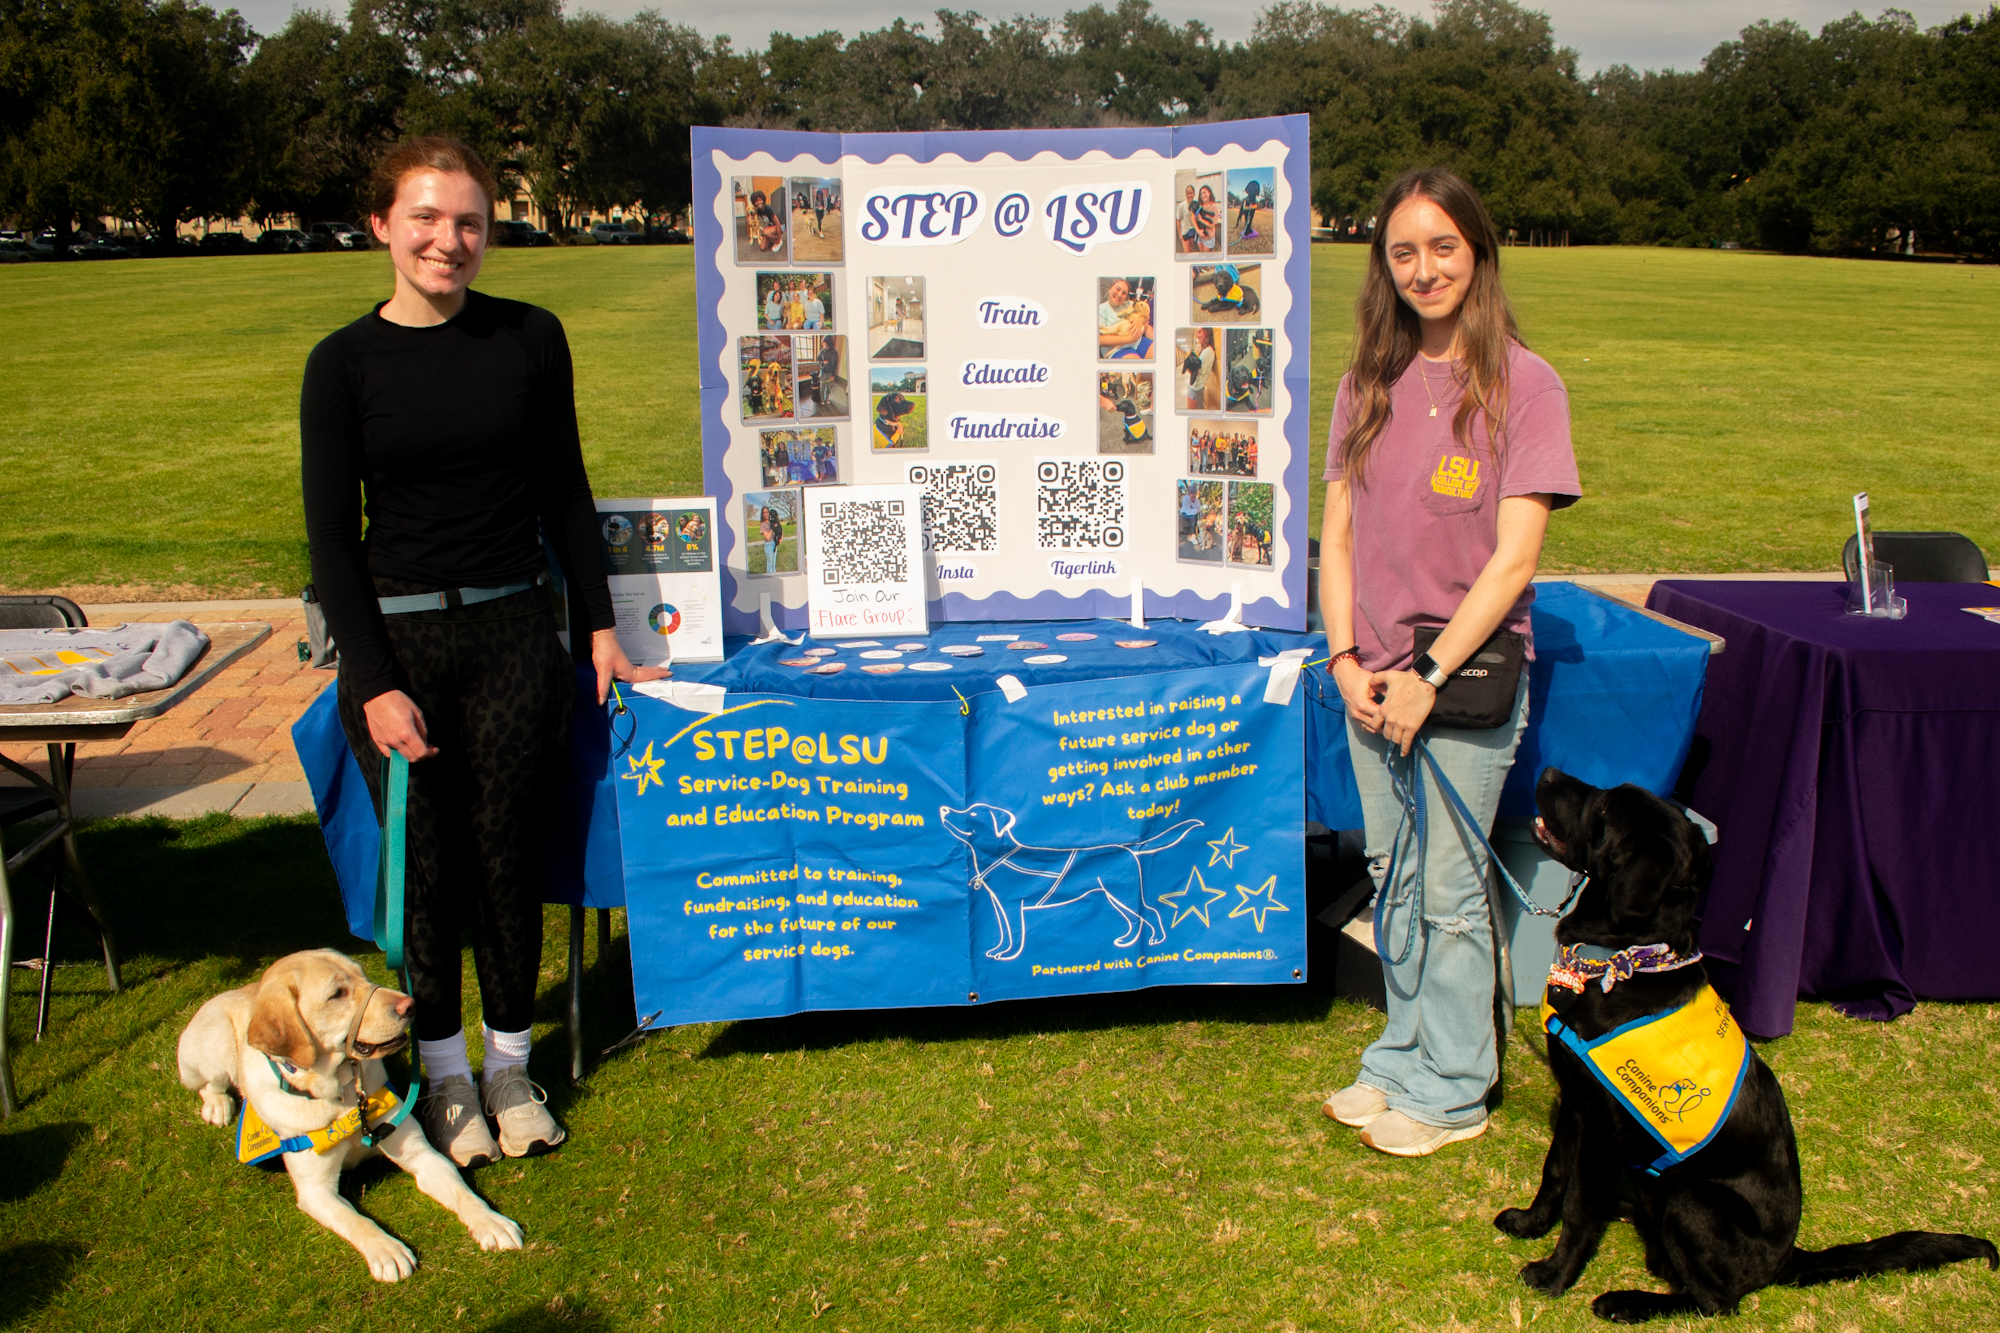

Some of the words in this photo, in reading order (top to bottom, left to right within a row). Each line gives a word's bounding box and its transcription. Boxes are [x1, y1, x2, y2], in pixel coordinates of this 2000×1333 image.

[862, 190, 978, 241] STEP
[994, 193, 1030, 237] @
[1046, 189, 1142, 252] LSU
[979, 301, 1041, 326] Train
[962, 362, 1049, 385] Educate
[950, 416, 1061, 439] Fundraise
[1437, 455, 1480, 481] LSU
[1433, 484, 1475, 499] AGRICULTURE
[1436, 475, 1464, 488] COLLEGE
[1464, 480, 1475, 490] OF
[645, 544, 665, 552] 4.7M
[686, 543, 699, 551] 8%
[936, 564, 975, 579] Insta
[1050, 560, 1118, 577] Tigerlink
[832, 589, 870, 603] Join
[875, 590, 900, 602] Our
[818, 609, 858, 628] Flare
[863, 608, 906, 625] Group
[1053, 700, 1145, 726] Interested
[1149, 703, 1164, 715] in
[1168, 695, 1226, 713] raising
[1230, 694, 1241, 705] a
[693, 726, 888, 765] STEP@LSU
[1059, 734, 1116, 751] future
[1120, 726, 1181, 746] service
[1186, 720, 1216, 739] dog
[1220, 720, 1239, 733] or
[1048, 761, 1109, 783] getting
[1114, 752, 1182, 770] involved
[1187, 748, 1202, 761] in
[1207, 743, 1250, 760] other
[678, 770, 811, 796] Service-Dog
[816, 775, 909, 801] Training
[1042, 782, 1095, 808] ways?
[1100, 781, 1135, 797] Ask
[1140, 783, 1150, 793] a
[1155, 773, 1189, 792] club
[1194, 763, 1257, 786] member
[667, 806, 708, 827] and
[715, 803, 820, 826] Education
[826, 805, 925, 831] Program
[1127, 798, 1180, 820] today!
[697, 863, 799, 889] Committed
[804, 867, 823, 880] to
[828, 867, 903, 888] training,
[684, 896, 791, 915] fundraising,
[796, 890, 828, 906] and
[832, 890, 919, 908] education
[709, 923, 738, 939] for
[744, 920, 774, 936] the
[780, 916, 836, 933] future
[841, 917, 861, 930] of
[866, 920, 897, 930] our
[744, 943, 806, 961] service
[811, 941, 855, 960] dogs.
[1031, 960, 1101, 976] Partnered
[1103, 958, 1133, 969] with
[1136, 952, 1180, 968] Canine
[1625, 1059, 1657, 1092] Canine
